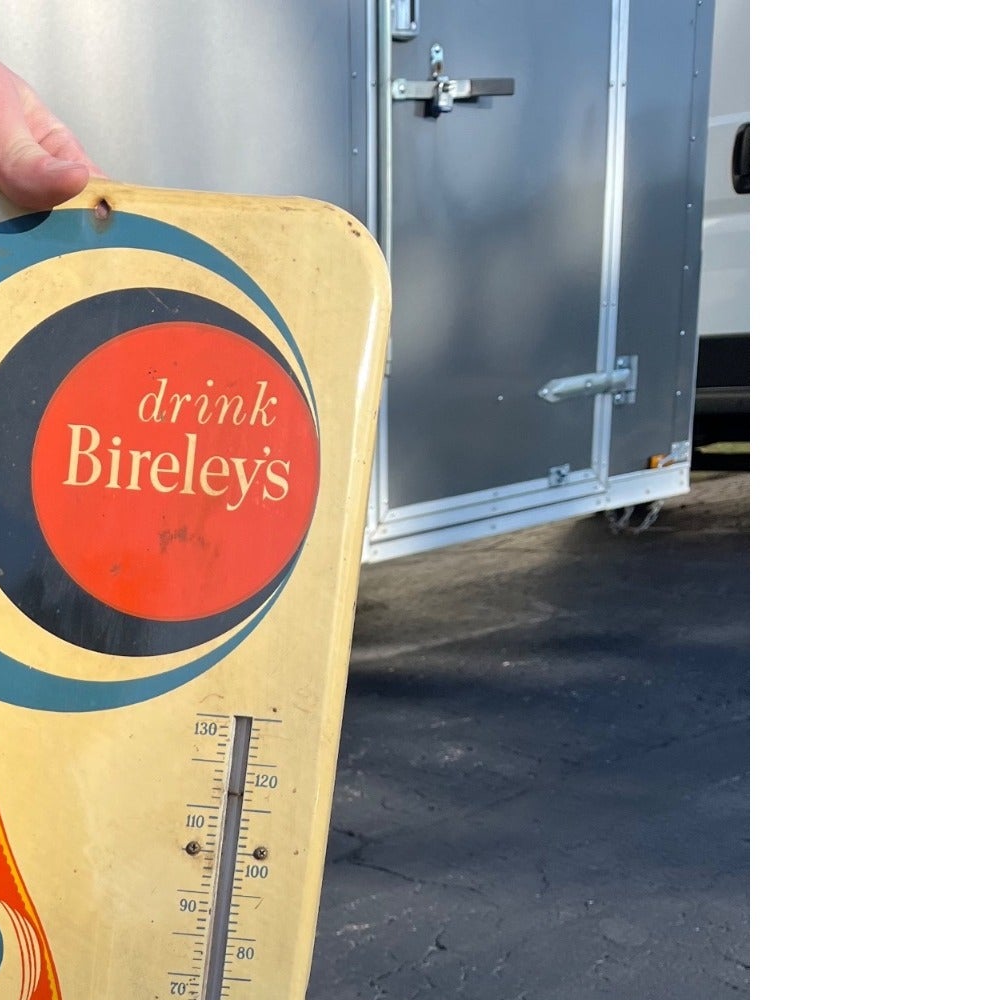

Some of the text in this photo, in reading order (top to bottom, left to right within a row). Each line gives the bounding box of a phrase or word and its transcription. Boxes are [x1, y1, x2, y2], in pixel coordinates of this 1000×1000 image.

[138, 378, 278, 427] drink
[62, 424, 291, 511] Bireley's
[194, 722, 217, 736] 130
[255, 774, 278, 789] 120
[186, 815, 204, 828] 110
[244, 865, 269, 879] 100
[180, 899, 197, 913] 90
[236, 947, 255, 960] 80
[170, 981, 186, 996] 70
